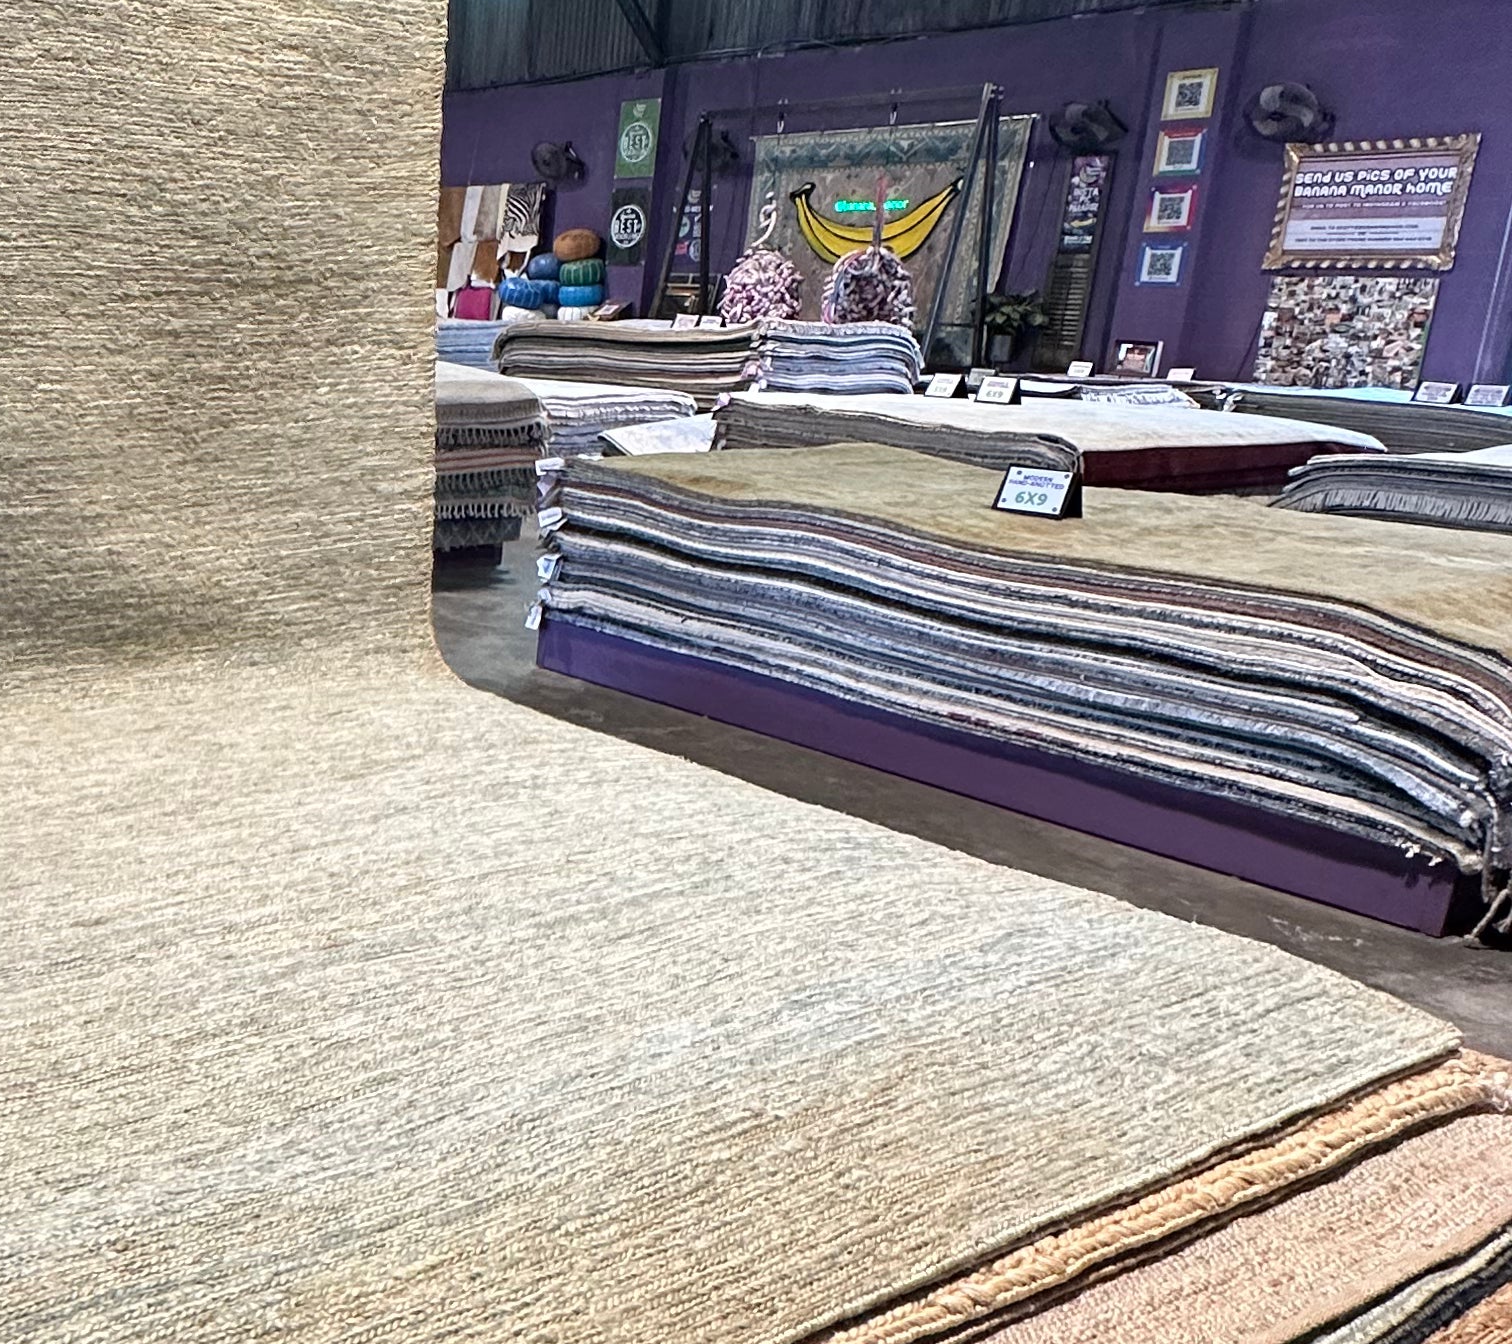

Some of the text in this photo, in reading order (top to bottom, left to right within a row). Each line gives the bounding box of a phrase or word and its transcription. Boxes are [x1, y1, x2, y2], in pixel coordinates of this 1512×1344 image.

[1335, 171, 1355, 183] US
[1394, 168, 1416, 180] OF
[1418, 167, 1458, 180] YOUR
[1294, 185, 1347, 197] BANANA
[1349, 182, 1403, 198] MANOR
[1014, 491, 1048, 506] 6X9
